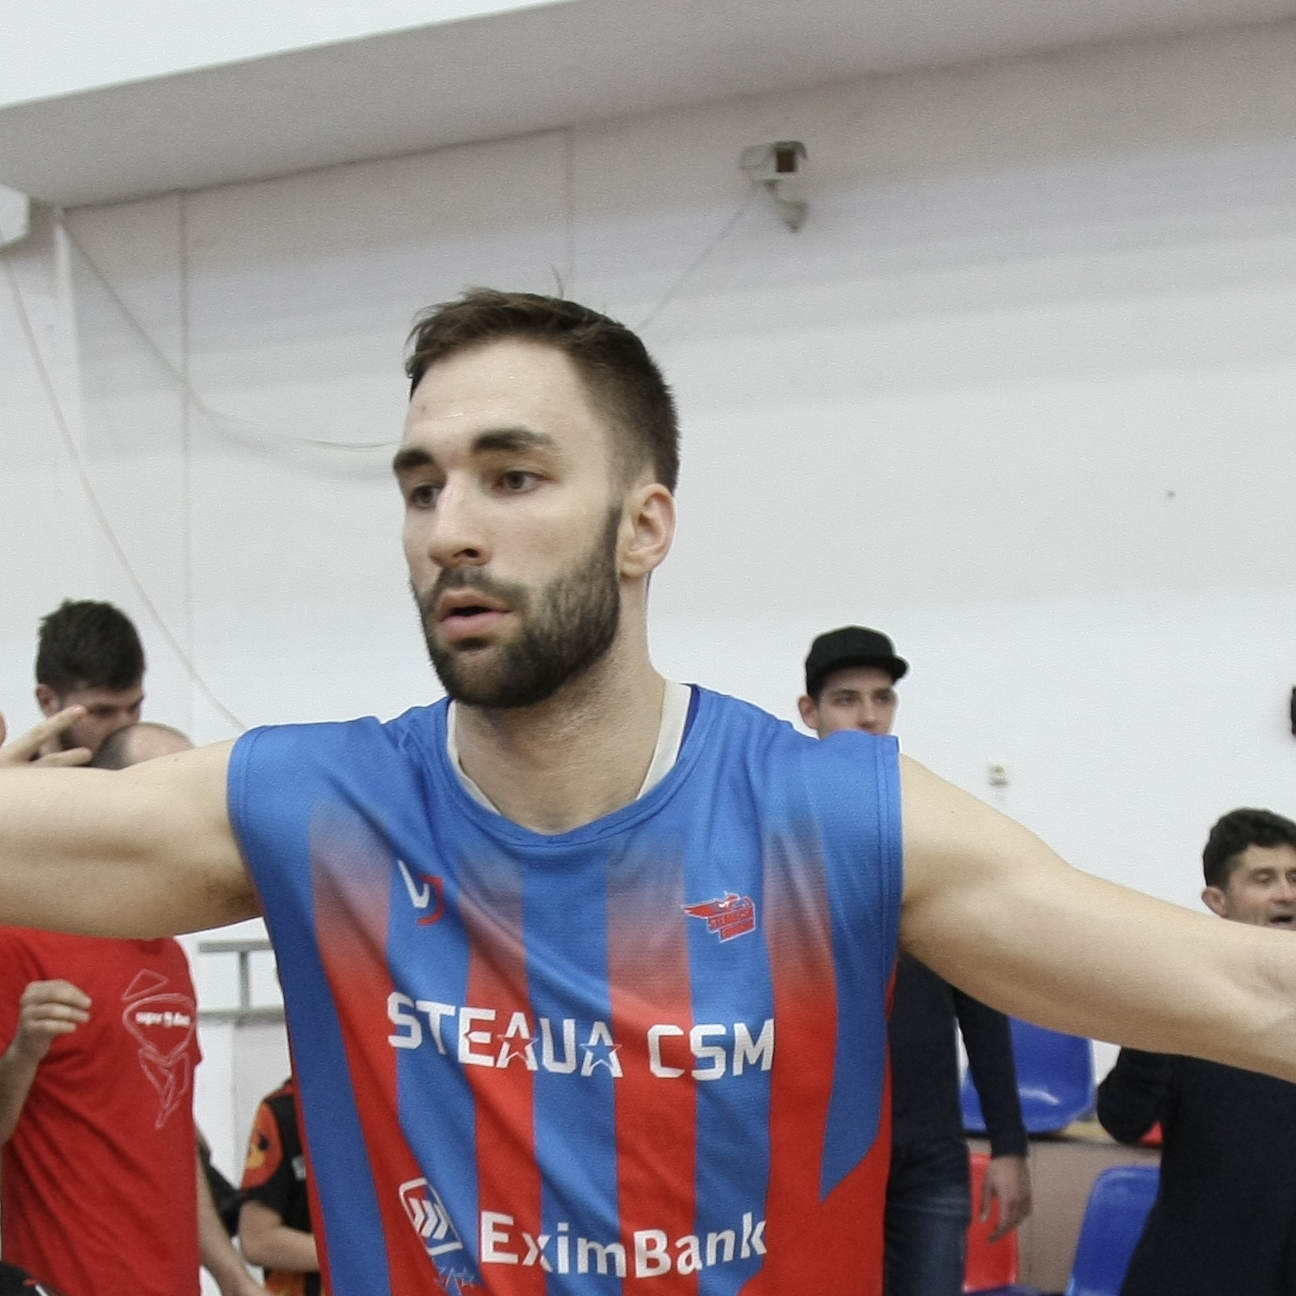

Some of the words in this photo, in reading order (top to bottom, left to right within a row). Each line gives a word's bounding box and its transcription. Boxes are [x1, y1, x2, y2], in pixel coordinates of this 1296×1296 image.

[387, 991, 624, 1079] STEAUA
[646, 1018, 775, 1081] CSM
[480, 1210, 768, 1279] EximBank
